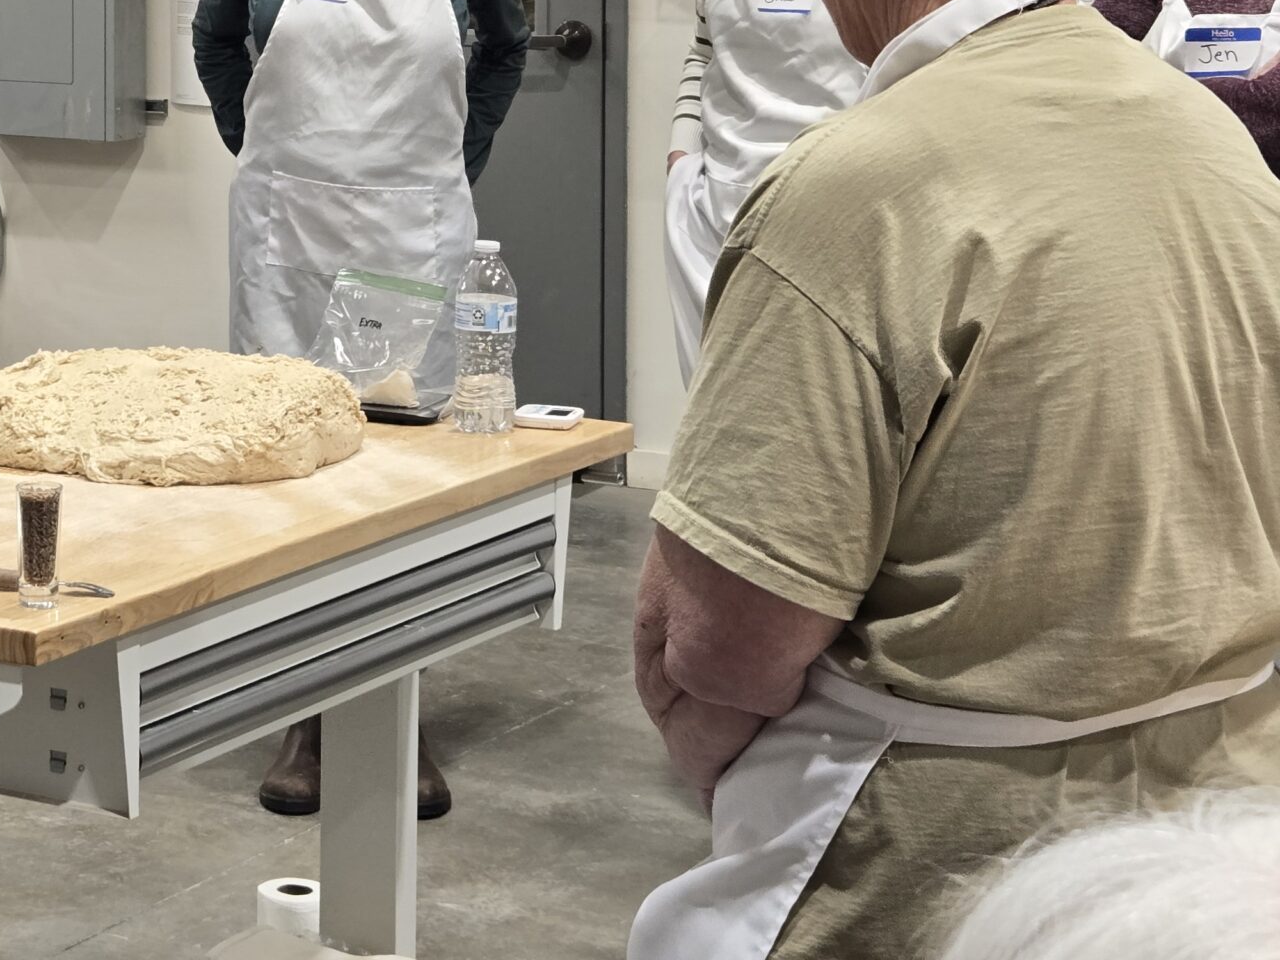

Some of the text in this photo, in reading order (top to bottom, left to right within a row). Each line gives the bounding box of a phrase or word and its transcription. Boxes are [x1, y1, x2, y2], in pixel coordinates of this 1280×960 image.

[1211, 29, 1235, 37] Hello
[1198, 43, 1238, 64] Jen
[359, 317, 382, 330] EXTRA
